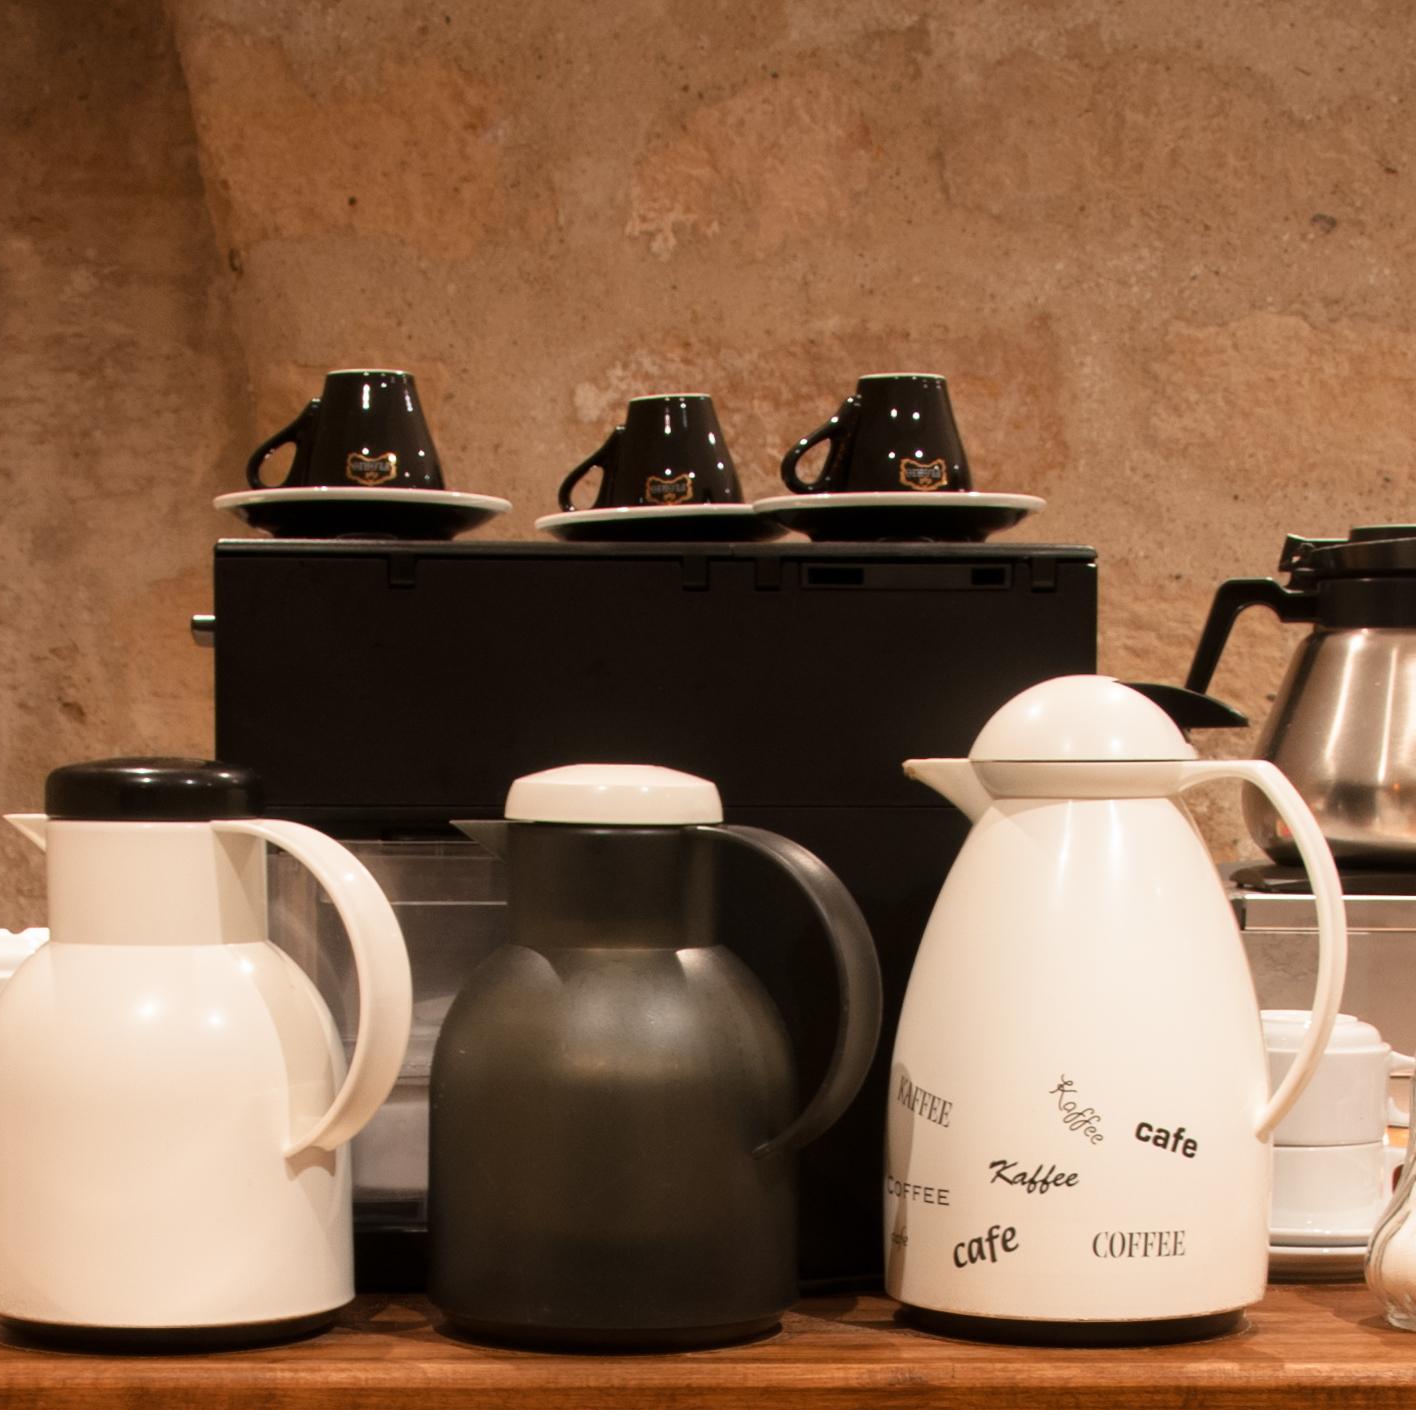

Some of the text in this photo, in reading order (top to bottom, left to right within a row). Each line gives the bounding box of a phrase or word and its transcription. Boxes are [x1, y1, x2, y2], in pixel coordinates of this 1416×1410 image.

[897, 1075, 953, 1128] KAFFEE
[1049, 1074, 1105, 1145] Kaffee
[1135, 1121, 1198, 1158] cafe
[887, 1176, 950, 1206] COFFEE
[988, 1159, 1080, 1194] Kaffee
[953, 1224, 1020, 1268] cafe
[1093, 1230, 1185, 1258] COFFEE
